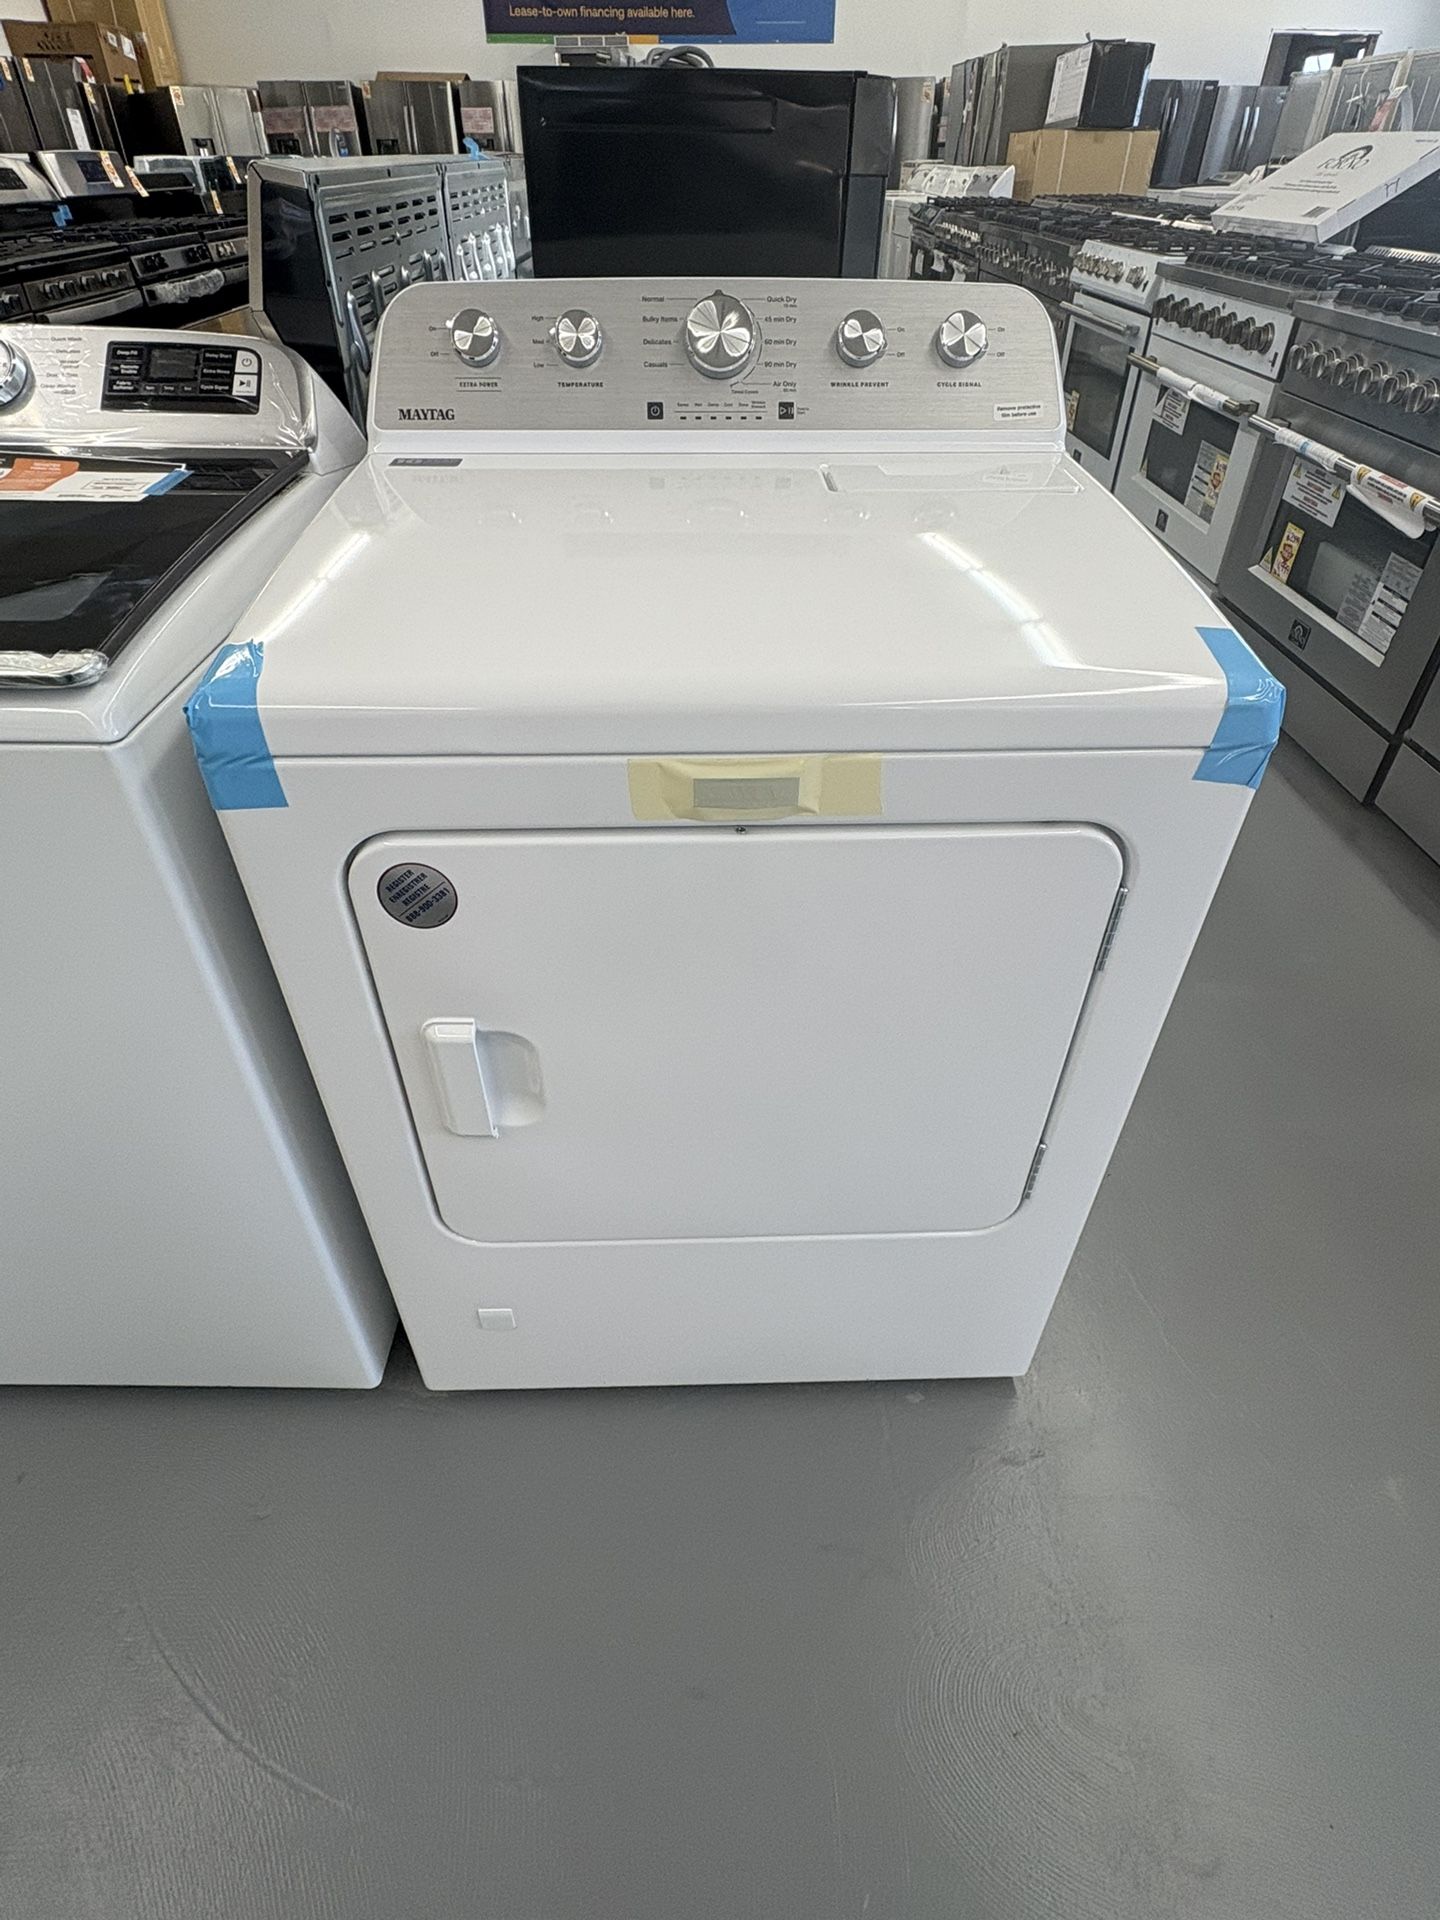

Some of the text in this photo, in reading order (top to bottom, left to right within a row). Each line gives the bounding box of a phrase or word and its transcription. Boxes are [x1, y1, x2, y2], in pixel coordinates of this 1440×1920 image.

[508, 4, 695, 20] Lease-to-own financing available here.
[786, 296, 798, 305] Dry
[642, 315, 659, 324] Bulky
[786, 316, 797, 325] Dry
[786, 339, 797, 348] Dry
[786, 361, 797, 370] Dry
[783, 381, 797, 390] Only
[1017, 404, 1042, 412] protective
[398, 408, 455, 421] MAYTAG
[385, 869, 415, 893] REGISTER
[388, 872, 428, 904] ENREGISTRER
[402, 883, 431, 907] REGISTRE
